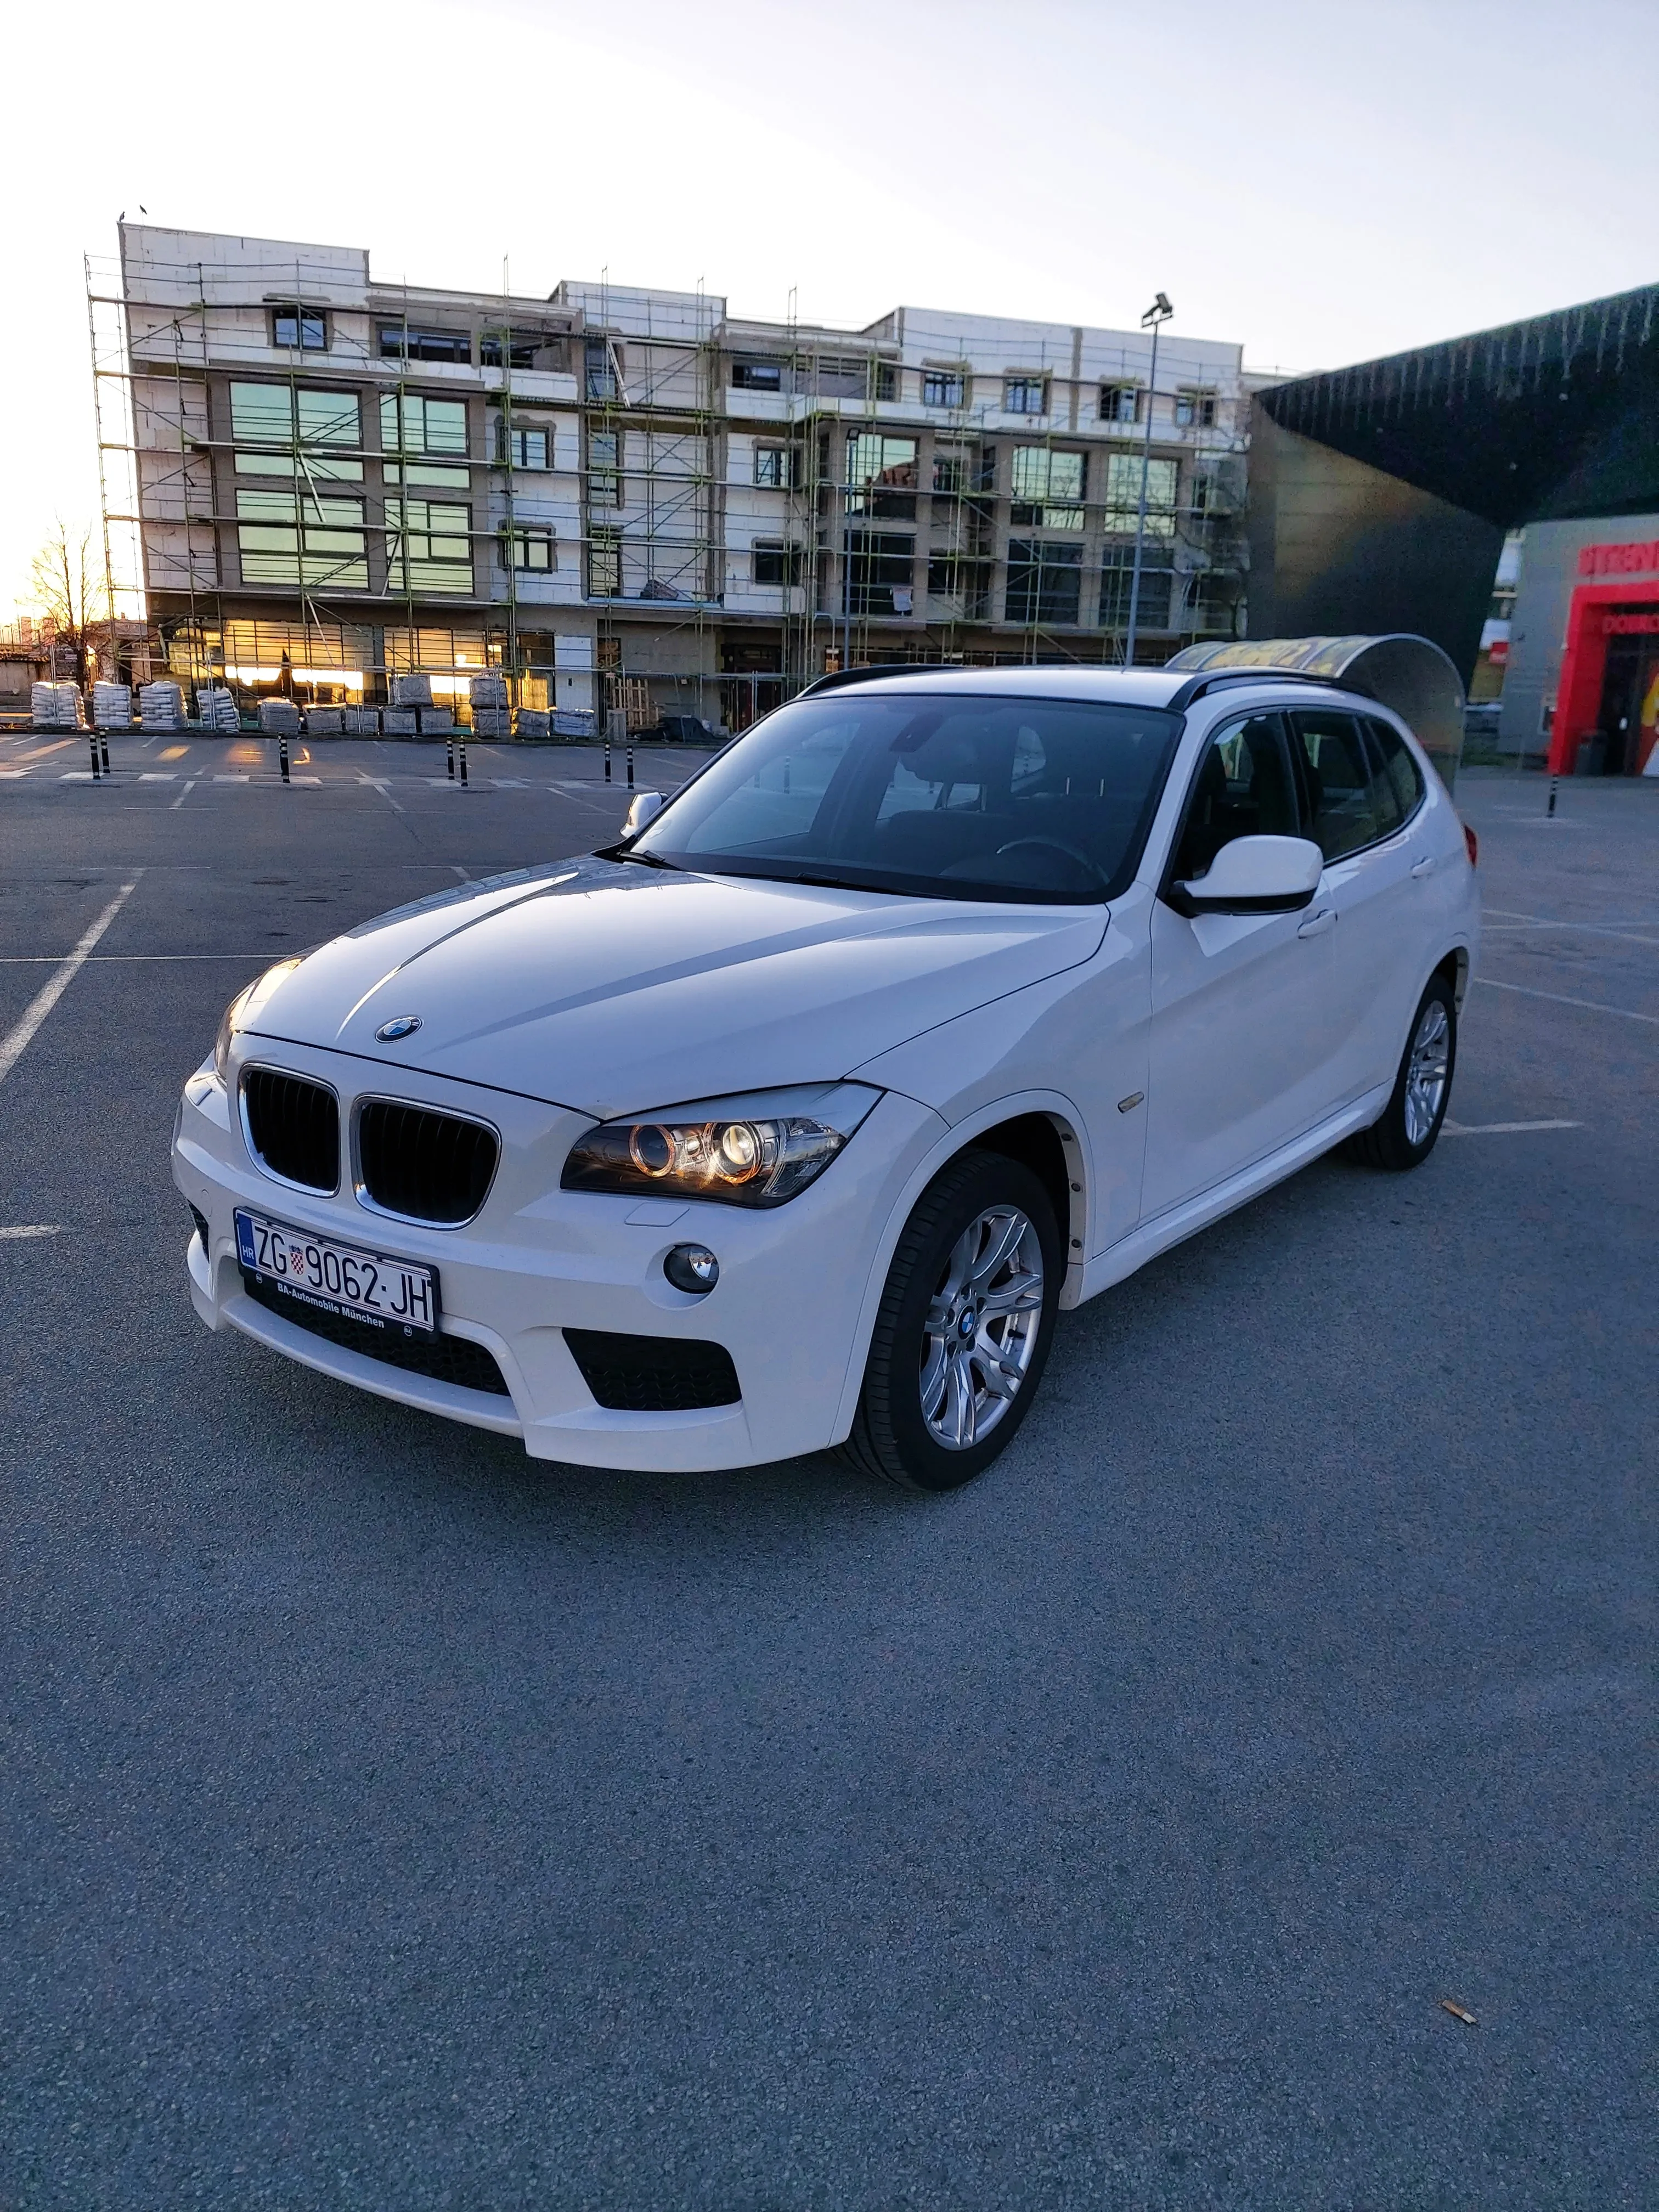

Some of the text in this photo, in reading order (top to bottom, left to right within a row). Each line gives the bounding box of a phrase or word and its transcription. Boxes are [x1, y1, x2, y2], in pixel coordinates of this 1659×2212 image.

[242, 1245, 255, 1260] HR
[255, 1226, 287, 1274] ZG
[277, 1283, 384, 1328] BA-Automobile München
